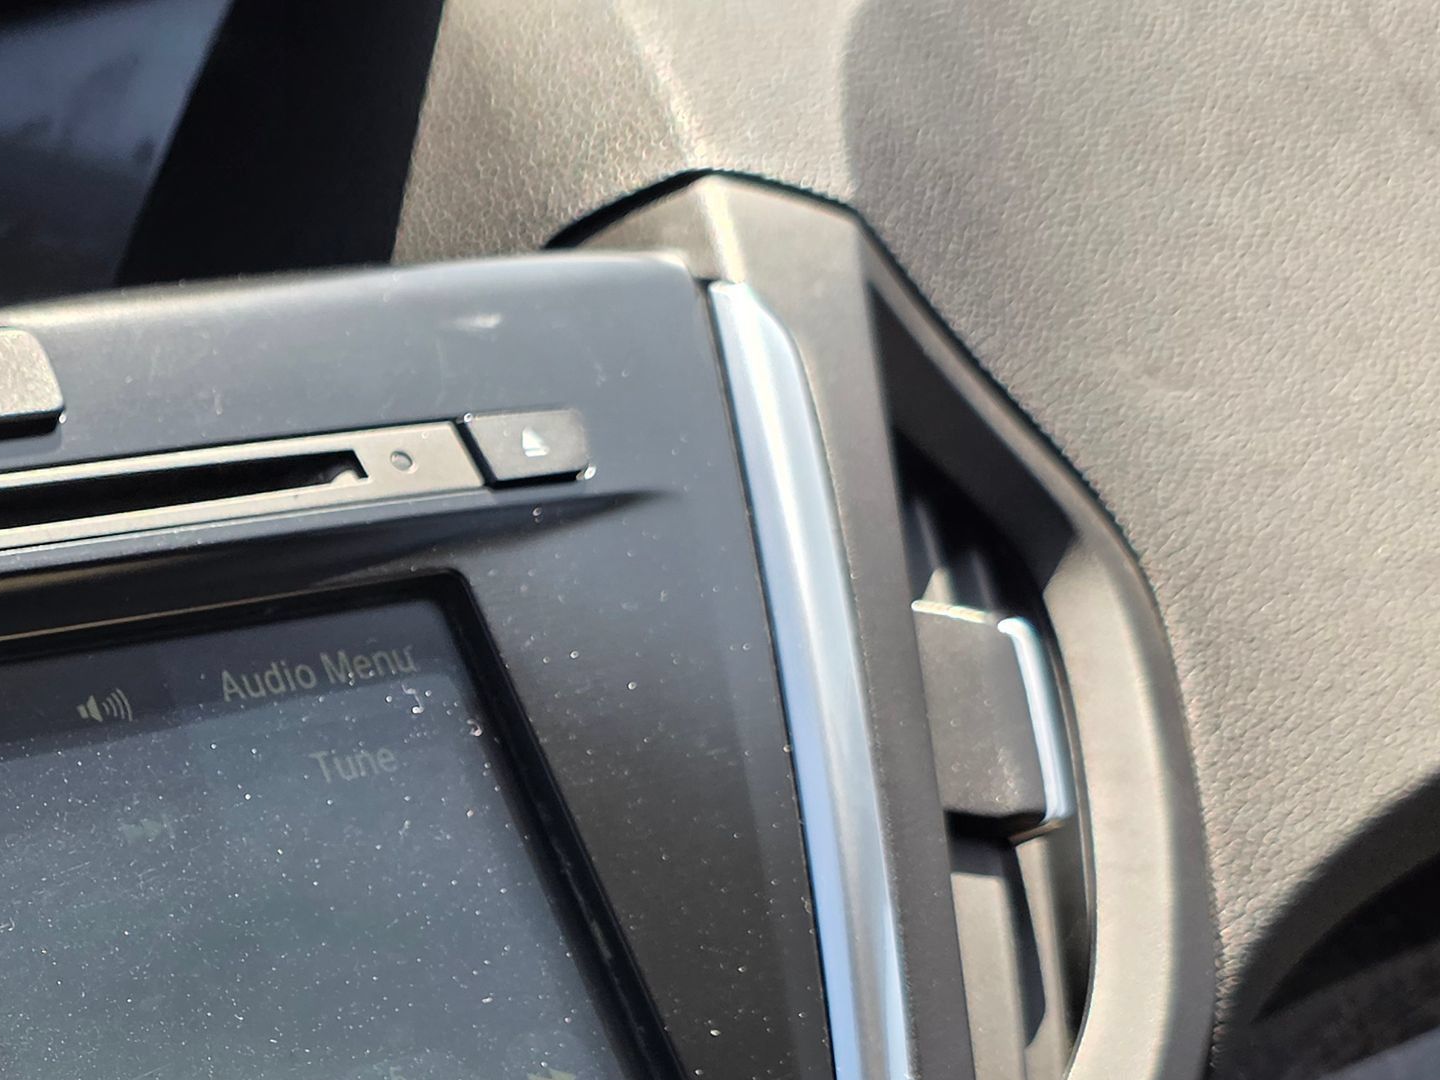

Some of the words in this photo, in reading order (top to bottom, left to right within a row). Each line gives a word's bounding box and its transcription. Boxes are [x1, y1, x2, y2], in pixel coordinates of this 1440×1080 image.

[220, 663, 317, 702] Audio
[321, 643, 418, 684] Menu
[310, 744, 398, 785] Tune
